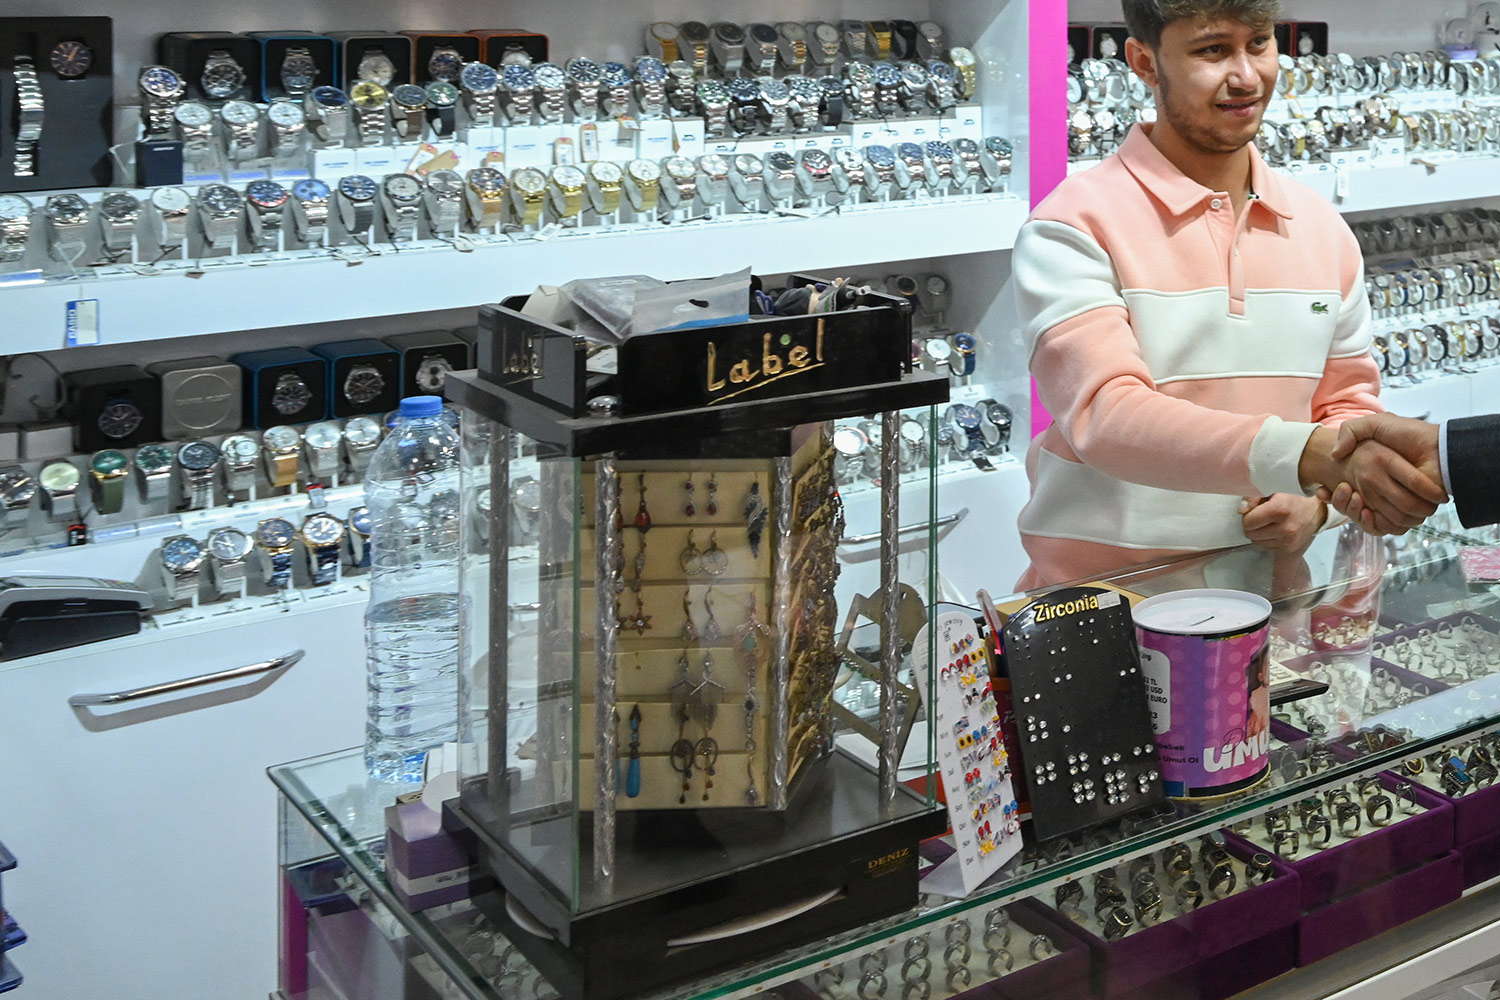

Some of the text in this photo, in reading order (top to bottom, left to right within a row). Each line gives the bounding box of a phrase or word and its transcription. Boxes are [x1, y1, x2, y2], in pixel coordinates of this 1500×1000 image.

[67, 309, 77, 339] CASIO
[707, 318, 825, 392] Label
[1034, 594, 1098, 622] Zirconia
[1150, 678, 1157, 686] TL
[1150, 686, 1163, 694] USD
[1150, 695, 1168, 704] EURO
[1163, 755, 1186, 763] Umut
